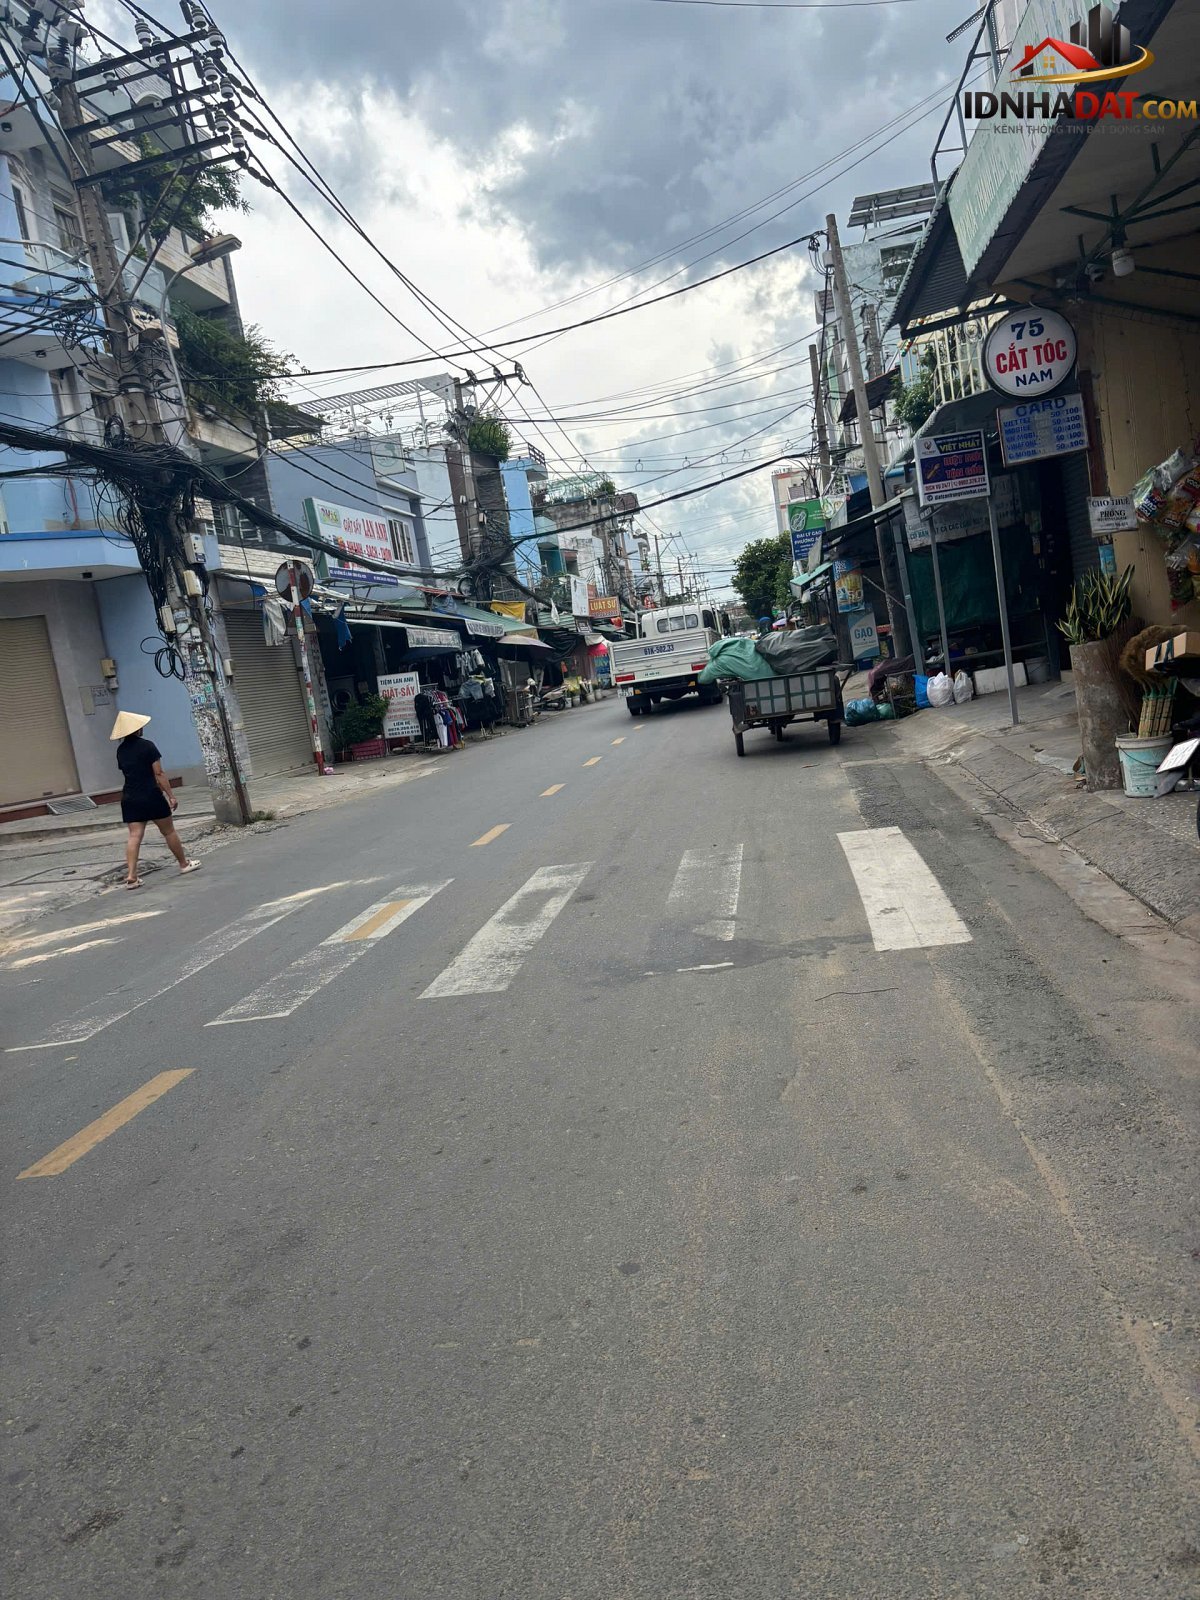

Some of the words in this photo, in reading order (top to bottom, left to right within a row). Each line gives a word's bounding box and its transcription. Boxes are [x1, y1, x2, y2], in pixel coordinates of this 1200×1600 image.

[1011, 317, 1044, 341] 75
[996, 342, 1028, 374] CẮT
[1033, 339, 1067, 365] TÓC
[1015, 368, 1053, 387] NAM
[1016, 397, 1066, 417] CARD
